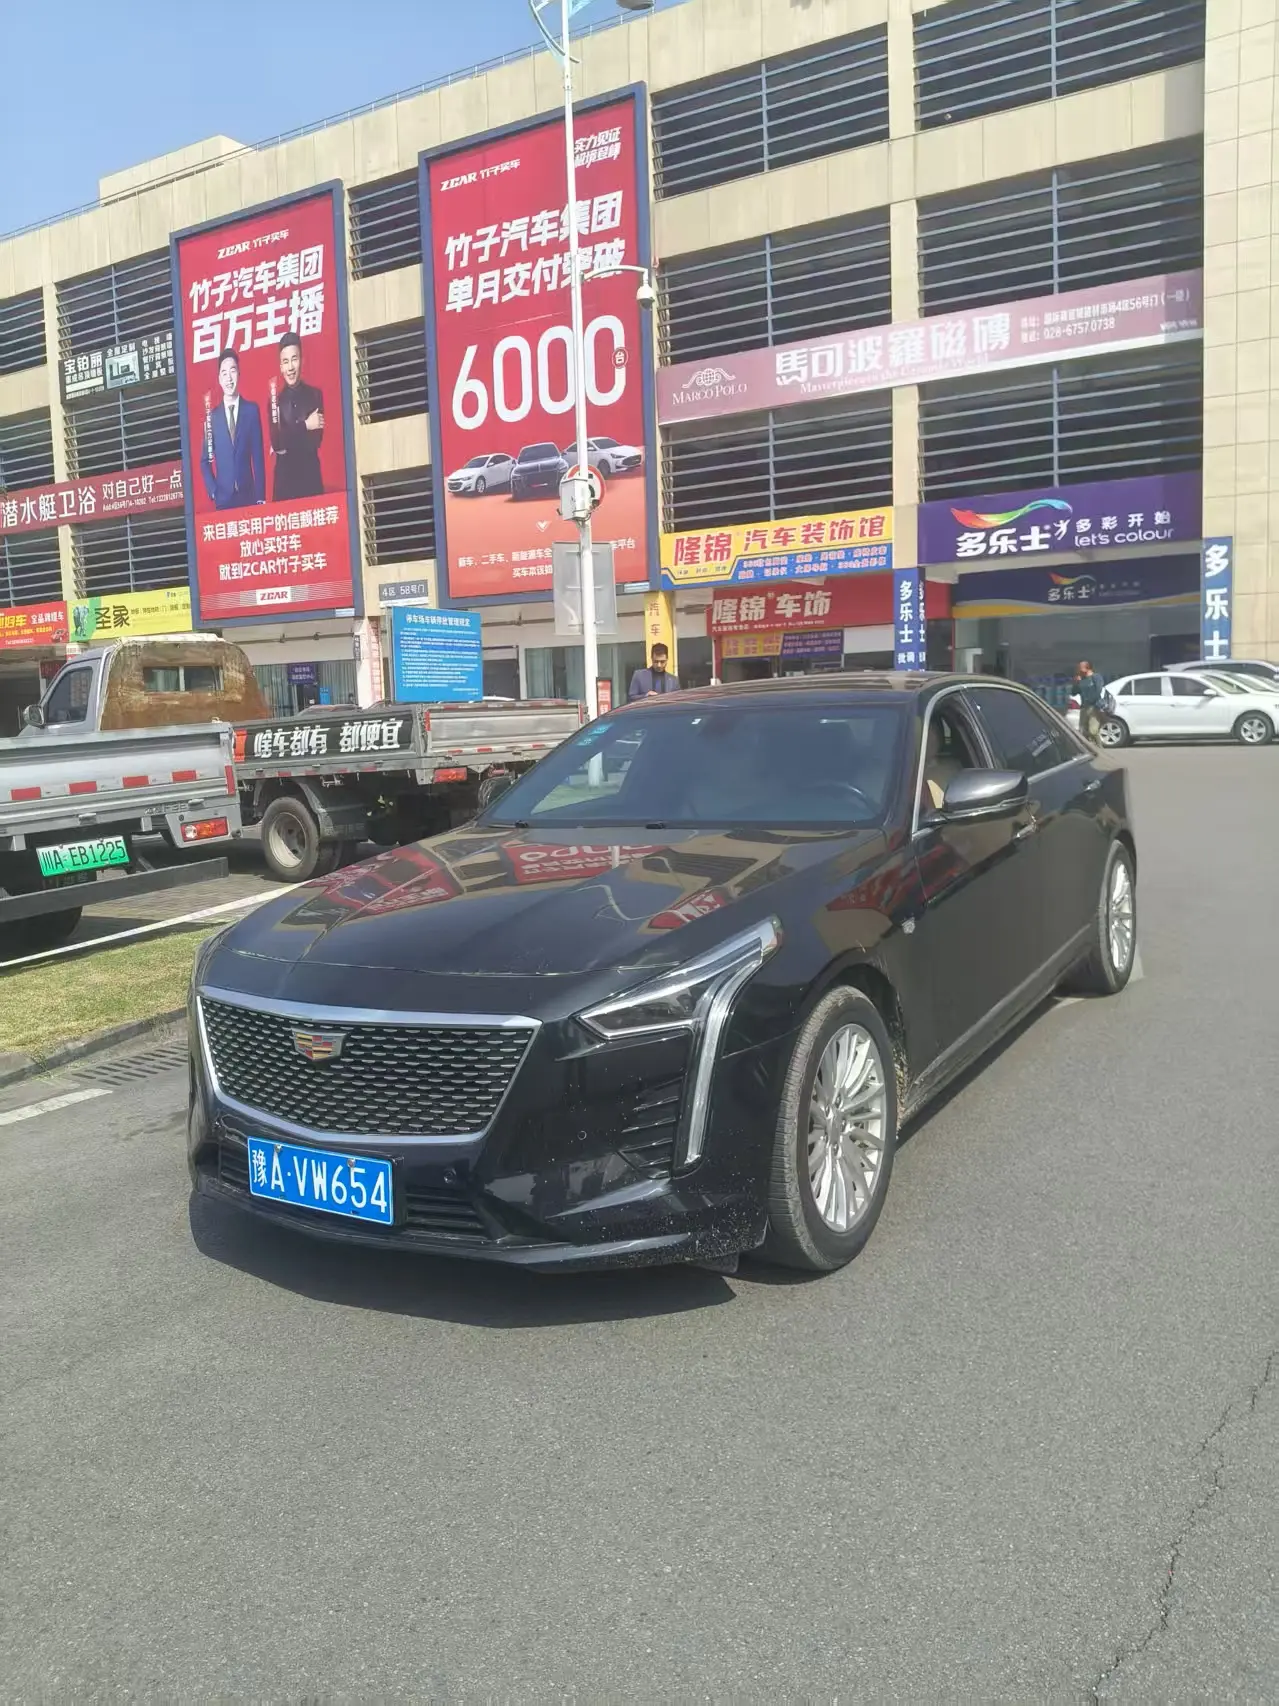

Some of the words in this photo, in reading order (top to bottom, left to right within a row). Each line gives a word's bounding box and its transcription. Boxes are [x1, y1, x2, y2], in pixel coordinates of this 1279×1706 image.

[440, 171, 477, 191] ZCAR
[444, 190, 623, 270] 竹子汽车集团
[217, 241, 251, 260] ZCAR
[189, 244, 324, 314] 竹子汽车集团
[445, 237, 626, 313] 单月交付突破
[191, 282, 325, 364] 百万主播
[452, 315, 627, 430] 6000
[715, 383, 747, 400] POLO
[1, 485, 96, 528] 潜水艇卫浴
[102, 469, 182, 500] 对自己好一点
[1075, 534, 1111, 548] let's
[1114, 527, 1175, 545] colour
[1076, 511, 1172, 534] 多彩开始
[240, 534, 302, 558] 放心买好车
[674, 532, 732, 567] 隆锦
[744, 515, 887, 552] 汽车装饰馆
[956, 528, 1051, 558] 多乐士
[219, 552, 328, 581] 就到ZCAR竹子买车
[260, 590, 289, 601] ZCAR
[774, 591, 832, 619] 车饰
[1204, 545, 1230, 661] 多乐士
[95, 604, 130, 631] 圣象
[899, 580, 914, 644] 多乐士
[338, 718, 404, 753] 都便宜
